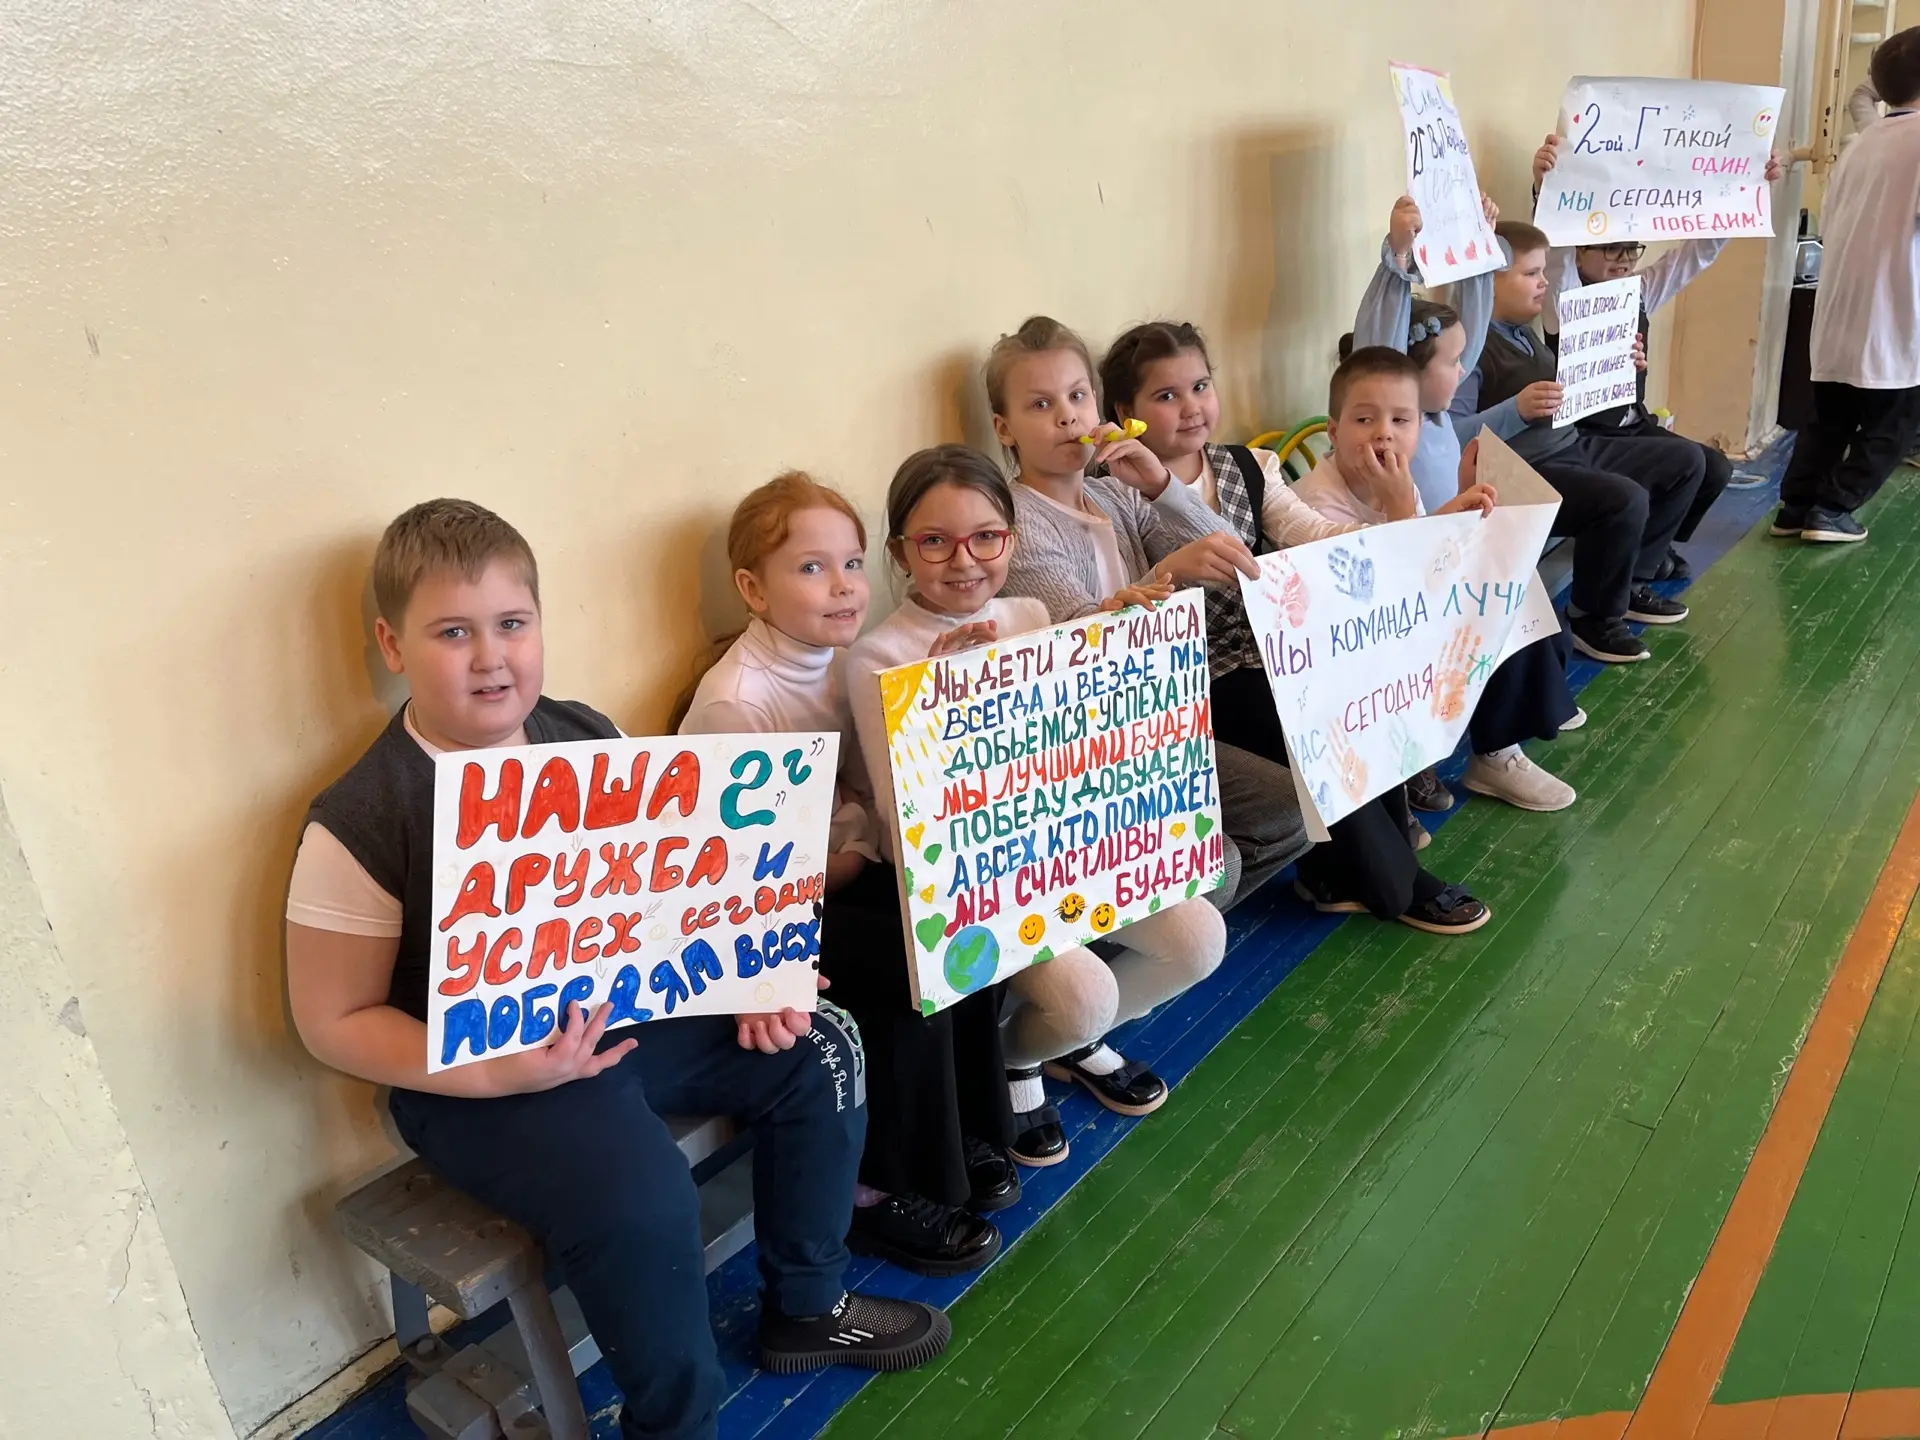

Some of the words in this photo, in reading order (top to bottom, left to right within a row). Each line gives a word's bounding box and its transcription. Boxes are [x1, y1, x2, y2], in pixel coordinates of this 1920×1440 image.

[1663, 124, 1732, 148] ТАКОЙ
[1692, 156, 1751, 175] ОДИН,
[1557, 191, 1594, 211] МЫ
[1610, 188, 1703, 209] СЕГОДНЯ
[1652, 186, 1765, 232] ПОБЕДИМ!
[1588, 360, 1598, 379] И
[1589, 328, 1605, 348] НАМ
[975, 640, 1054, 695] ДЕТИ
[1127, 602, 1200, 649] КЛАССА
[1330, 591, 1428, 658] КОМАНДА
[943, 682, 1044, 741] ВСЕГДА
[1054, 679, 1068, 708] И
[1077, 648, 1157, 701] ВЕЗДЕ
[1170, 637, 1207, 674] МЫ
[1096, 667, 1206, 732] УСПЕХА!!!
[1344, 663, 1434, 733] СЕГОДНЯ
[933, 769, 988, 822] МЫ
[993, 727, 1126, 800] ЛУЧШИМИ
[1131, 698, 1214, 758] БУДЕМ,
[950, 780, 1067, 852] ПОБЕДУ
[1072, 734, 1210, 807] ДОБУДЕМ!
[456, 749, 701, 850] НАША
[947, 854, 970, 898] А
[1047, 809, 1099, 859] КТО
[1105, 767, 1217, 838] ПОМОЖЕТ,
[438, 835, 728, 932] ДРУЖБА
[752, 841, 795, 881] И
[944, 877, 1000, 938] МЫ
[1015, 818, 1163, 907] СЧАСТЛИВЫ
[1116, 833, 1224, 908] БУДЕМ!!!
[820, 1041, 842, 1071] Style
